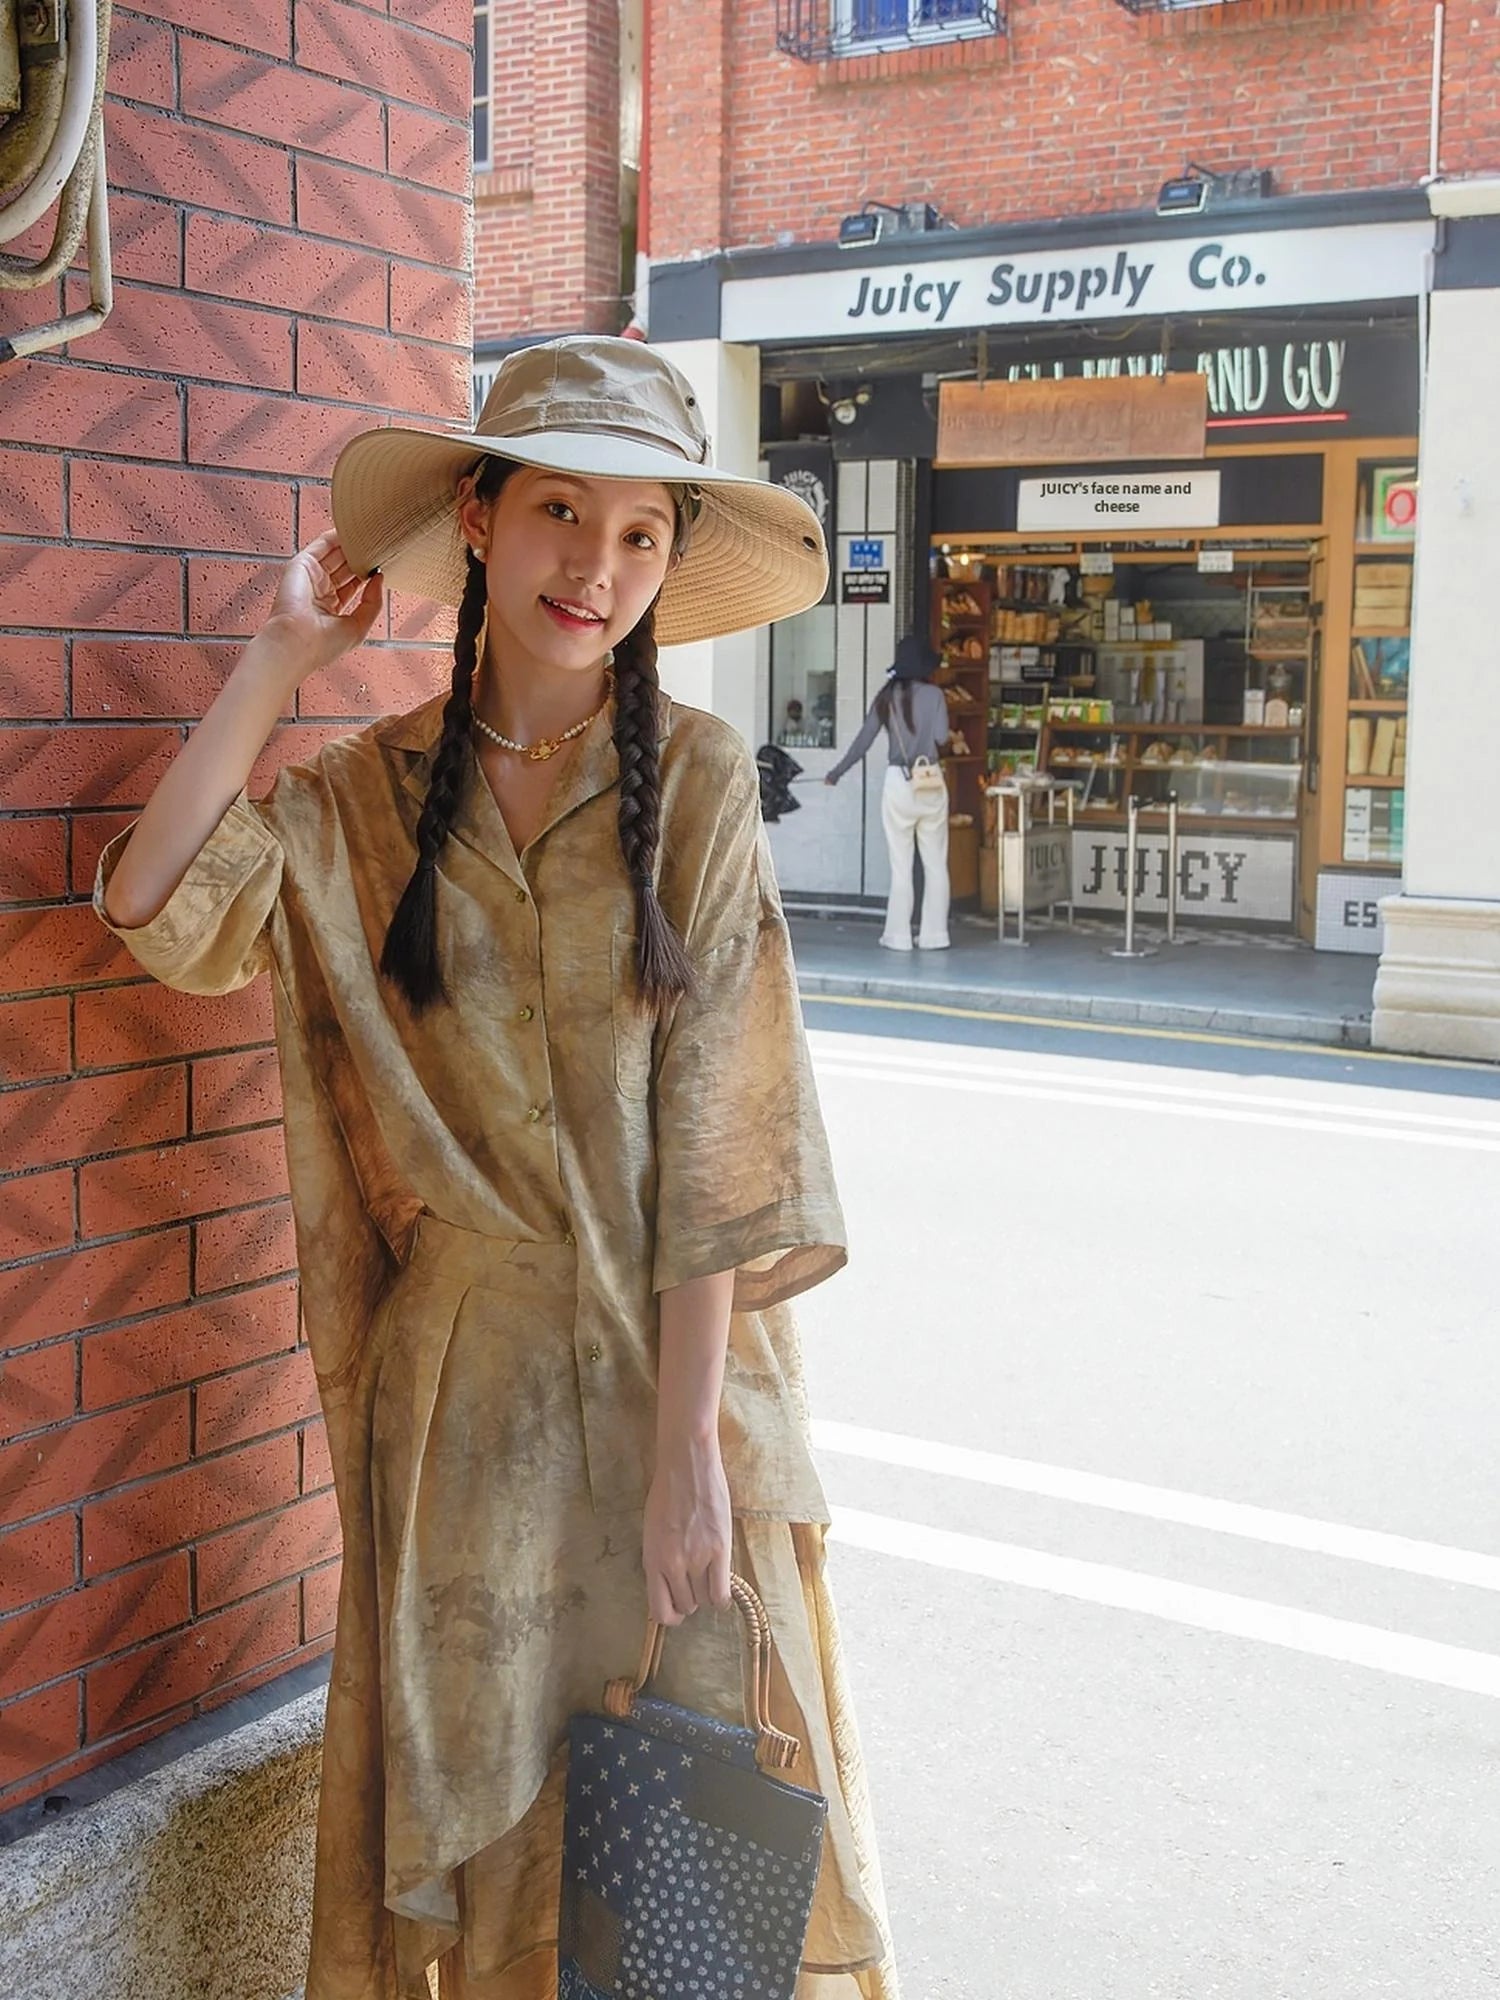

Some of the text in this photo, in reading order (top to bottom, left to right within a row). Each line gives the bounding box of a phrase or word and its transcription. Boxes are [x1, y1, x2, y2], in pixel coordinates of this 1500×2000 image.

[848, 243, 1267, 322] Juicy Supply Co.
[1197, 345, 1269, 413] AND
[1282, 340, 1345, 411] GO
[1040, 481, 1192, 497] JUICY's face name and
[1094, 500, 1140, 513] cheese
[1082, 844, 1247, 903] JUICY
